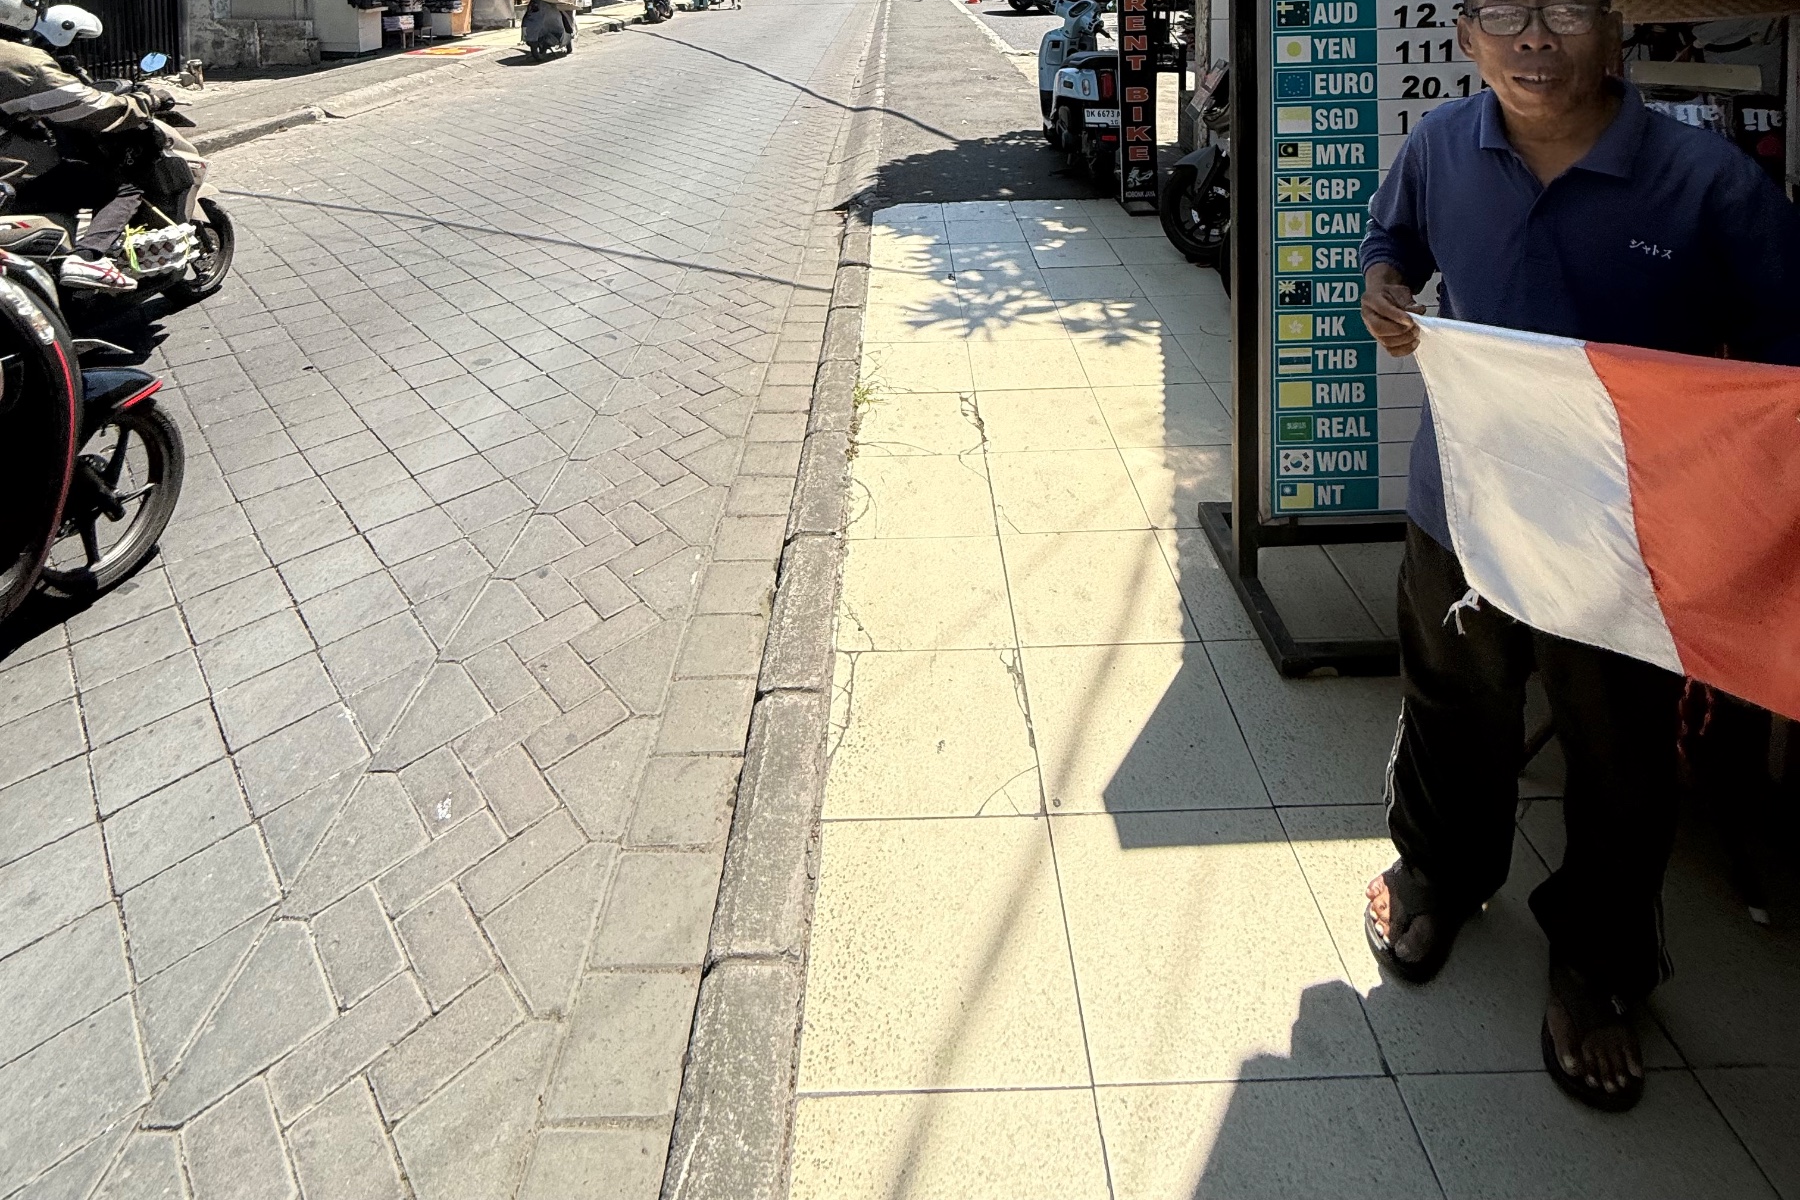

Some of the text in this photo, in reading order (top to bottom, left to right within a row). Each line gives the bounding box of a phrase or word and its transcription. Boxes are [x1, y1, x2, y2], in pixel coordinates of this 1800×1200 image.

[1313, 2, 1358, 25] AUD
[1314, 37, 1356, 60] YEN
[1314, 72, 1374, 95] EURO
[1086, 109, 1096, 118] DK
[1097, 109, 1115, 118] 6673
[1125, 86, 1152, 162] BIKE
[1315, 108, 1359, 131] SGD
[1742, 108, 1783, 132] ali
[1315, 143, 1365, 165] MYR
[1315, 178, 1361, 200] GBP
[1315, 213, 1361, 235] CAN
[1315, 247, 1358, 269] SFR
[1316, 282, 1359, 303] NZD
[1316, 315, 1346, 337] HK
[1314, 348, 1358, 370] THB
[1315, 382, 1366, 404] RMB
[1316, 416, 1371, 438] REAL
[1316, 450, 1368, 472] WON
[1317, 485, 1345, 506] NT
